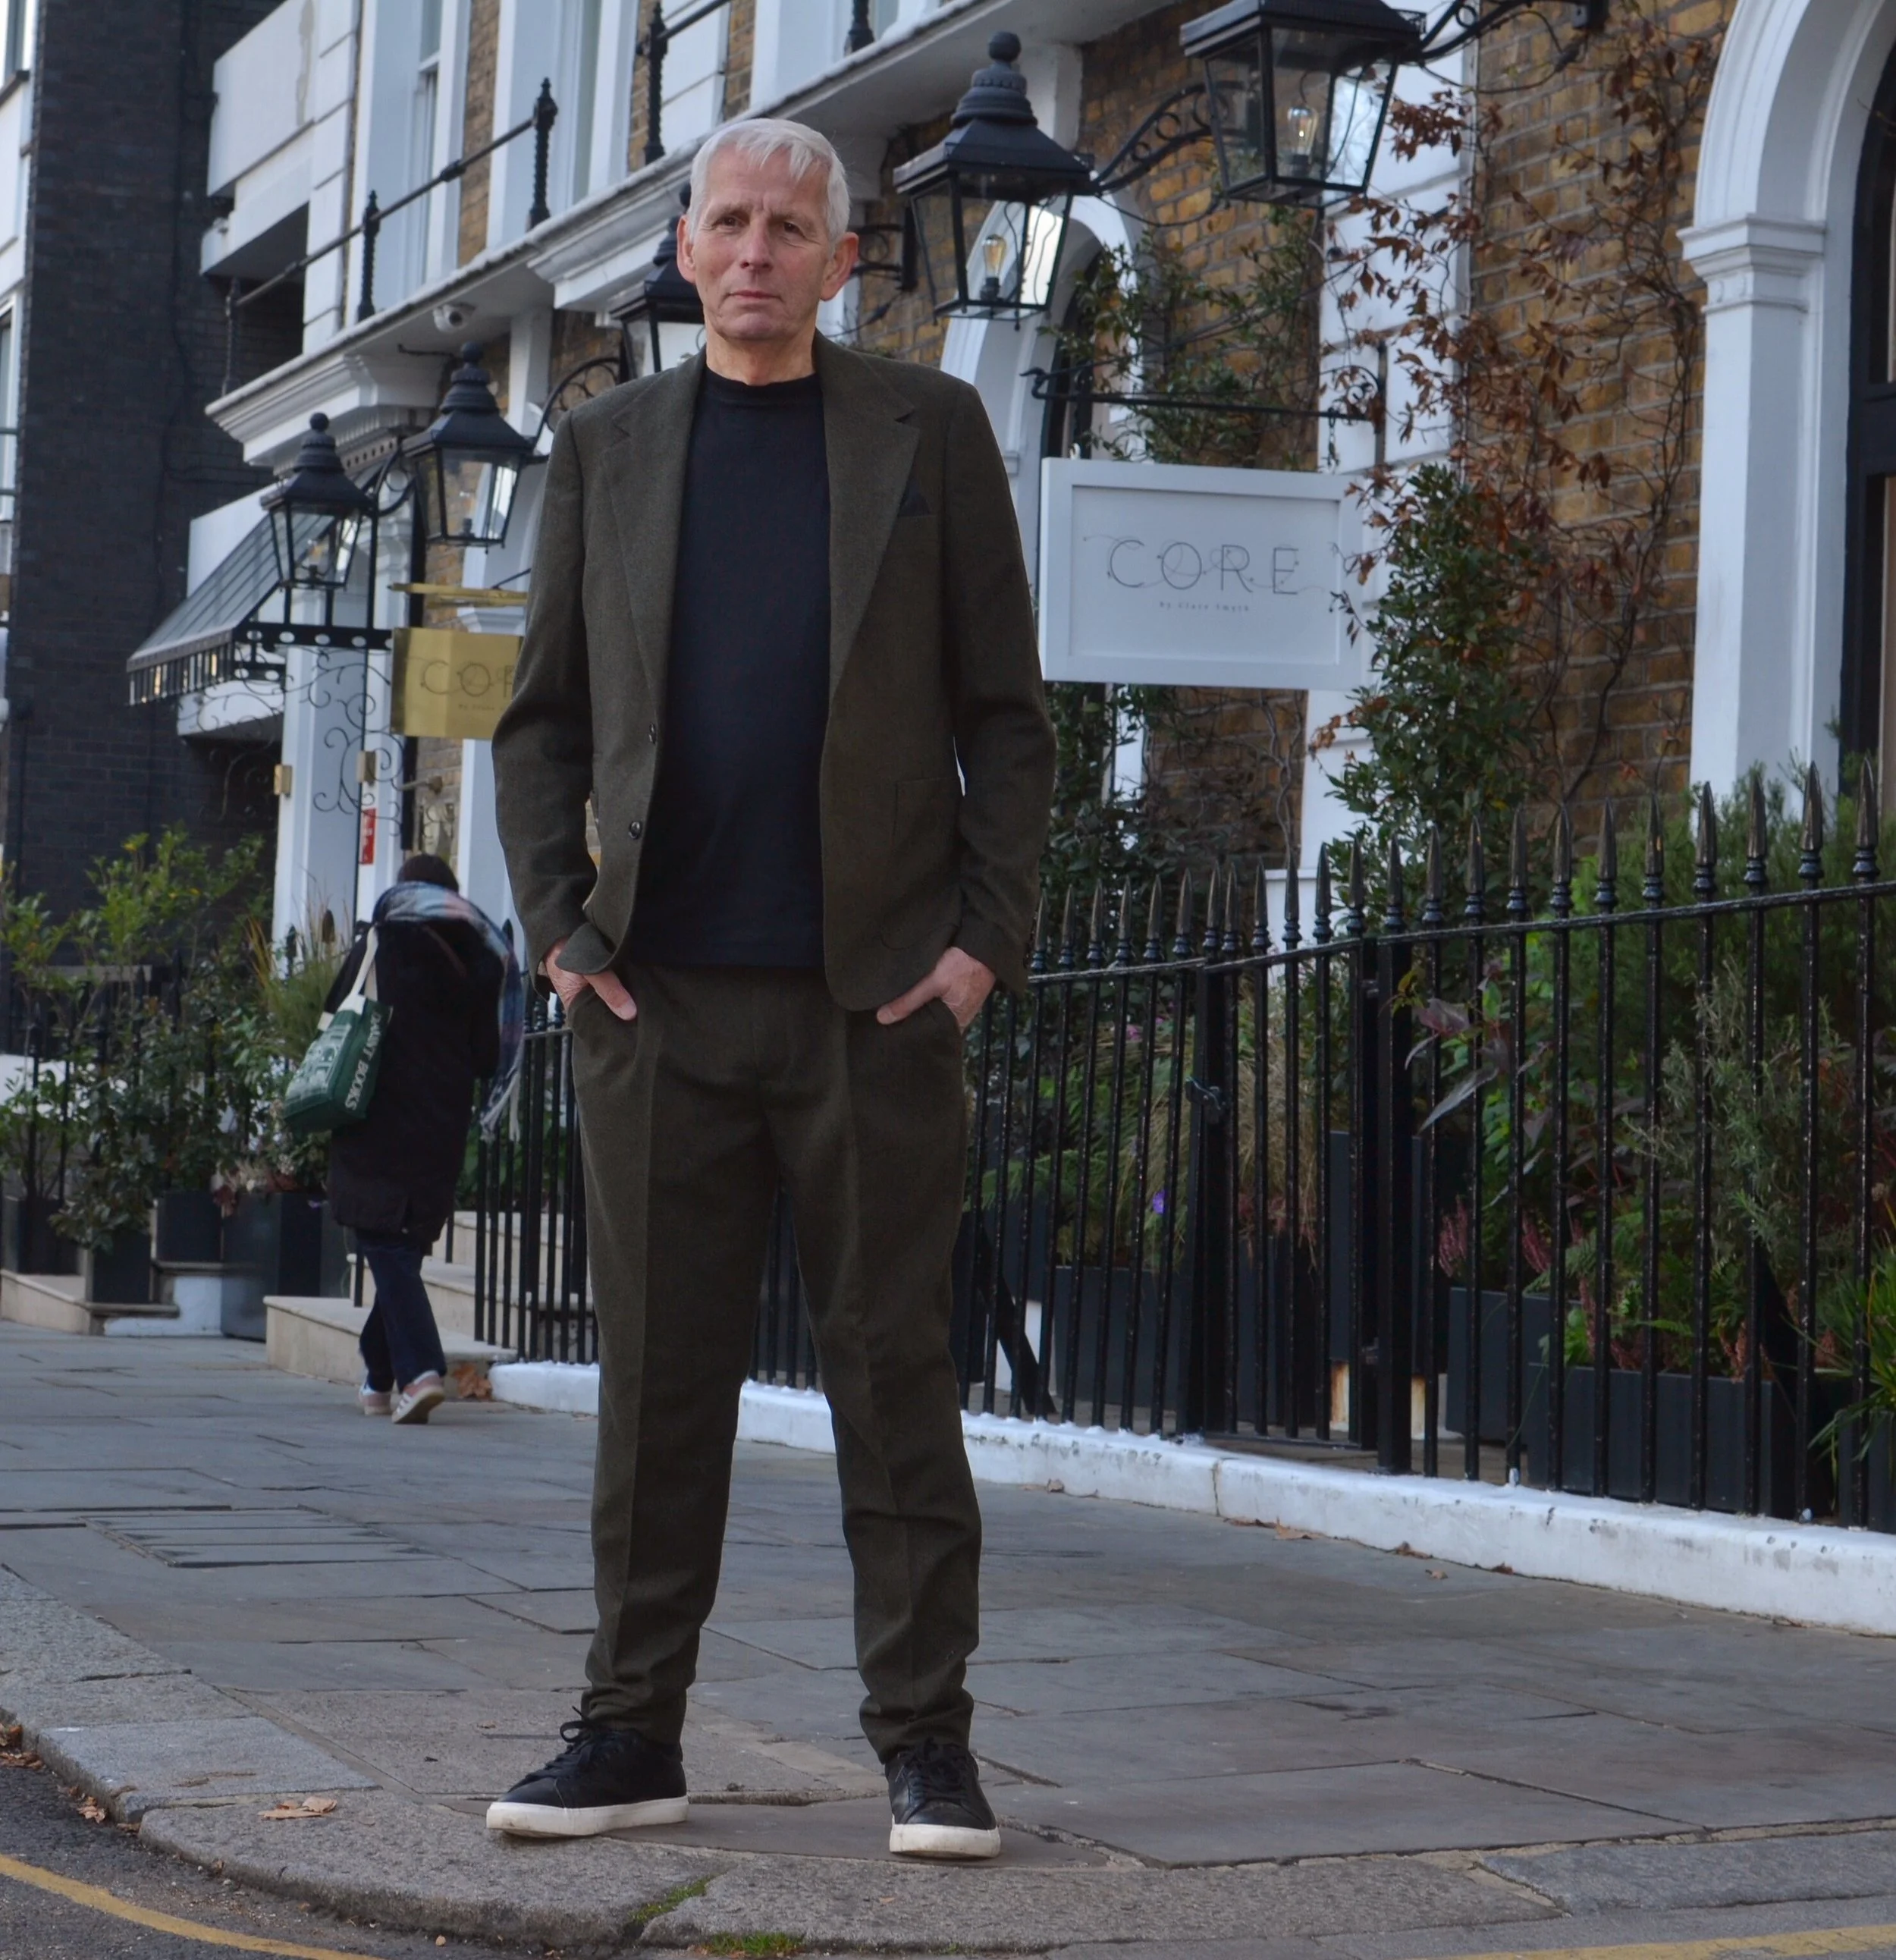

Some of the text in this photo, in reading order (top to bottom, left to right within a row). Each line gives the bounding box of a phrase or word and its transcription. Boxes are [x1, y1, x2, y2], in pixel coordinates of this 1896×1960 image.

[1110, 539, 1299, 595] CORE
[344, 1011, 382, 1111] DAUNT BOOKS
